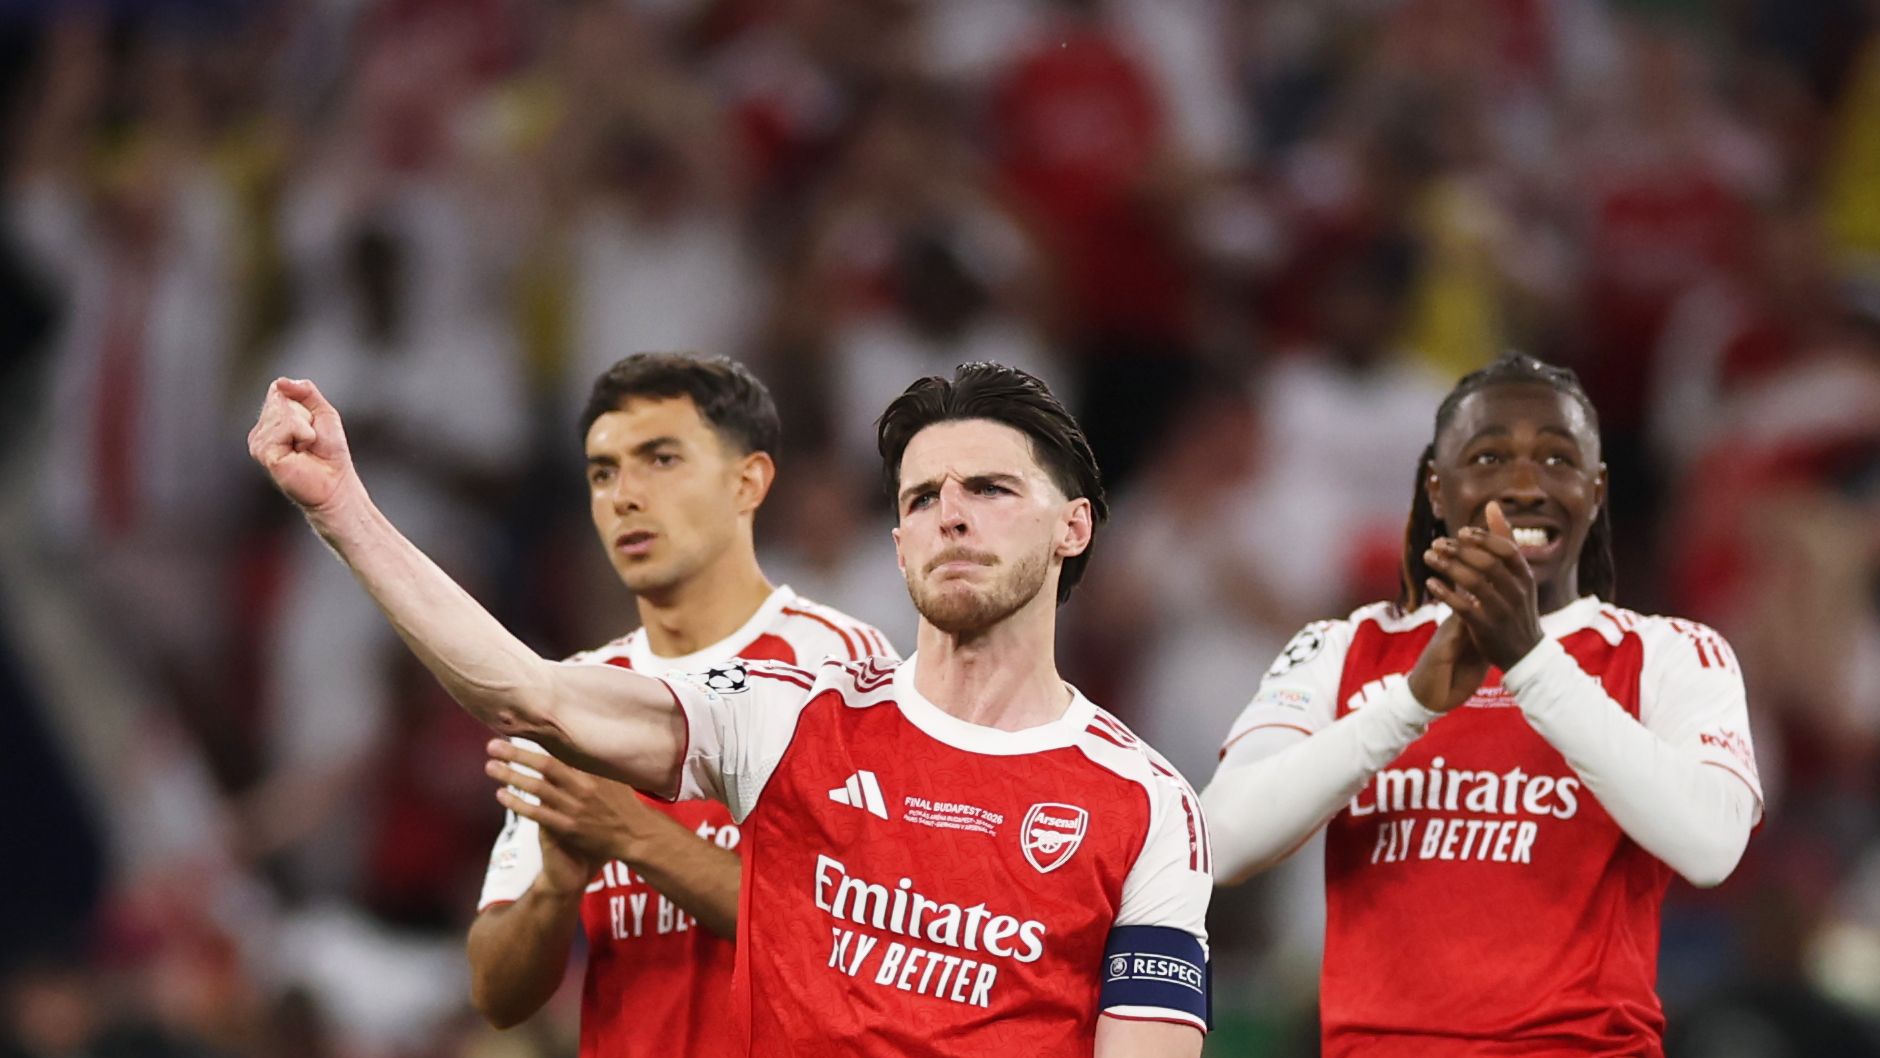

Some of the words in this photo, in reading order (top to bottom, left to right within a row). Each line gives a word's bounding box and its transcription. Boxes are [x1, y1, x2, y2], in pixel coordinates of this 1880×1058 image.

[904, 796, 932, 811] FINAL
[933, 802, 982, 817] BUDAPEST
[981, 810, 1004, 825] 2026
[1034, 812, 1080, 829] Arsenal
[1370, 818, 1416, 864] FLY
[1418, 818, 1538, 864] BETTER
[609, 892, 648, 940] FLY
[815, 853, 1046, 963] Emirates
[874, 942, 998, 1008] BETTER
[1133, 958, 1202, 988] RESPECT
